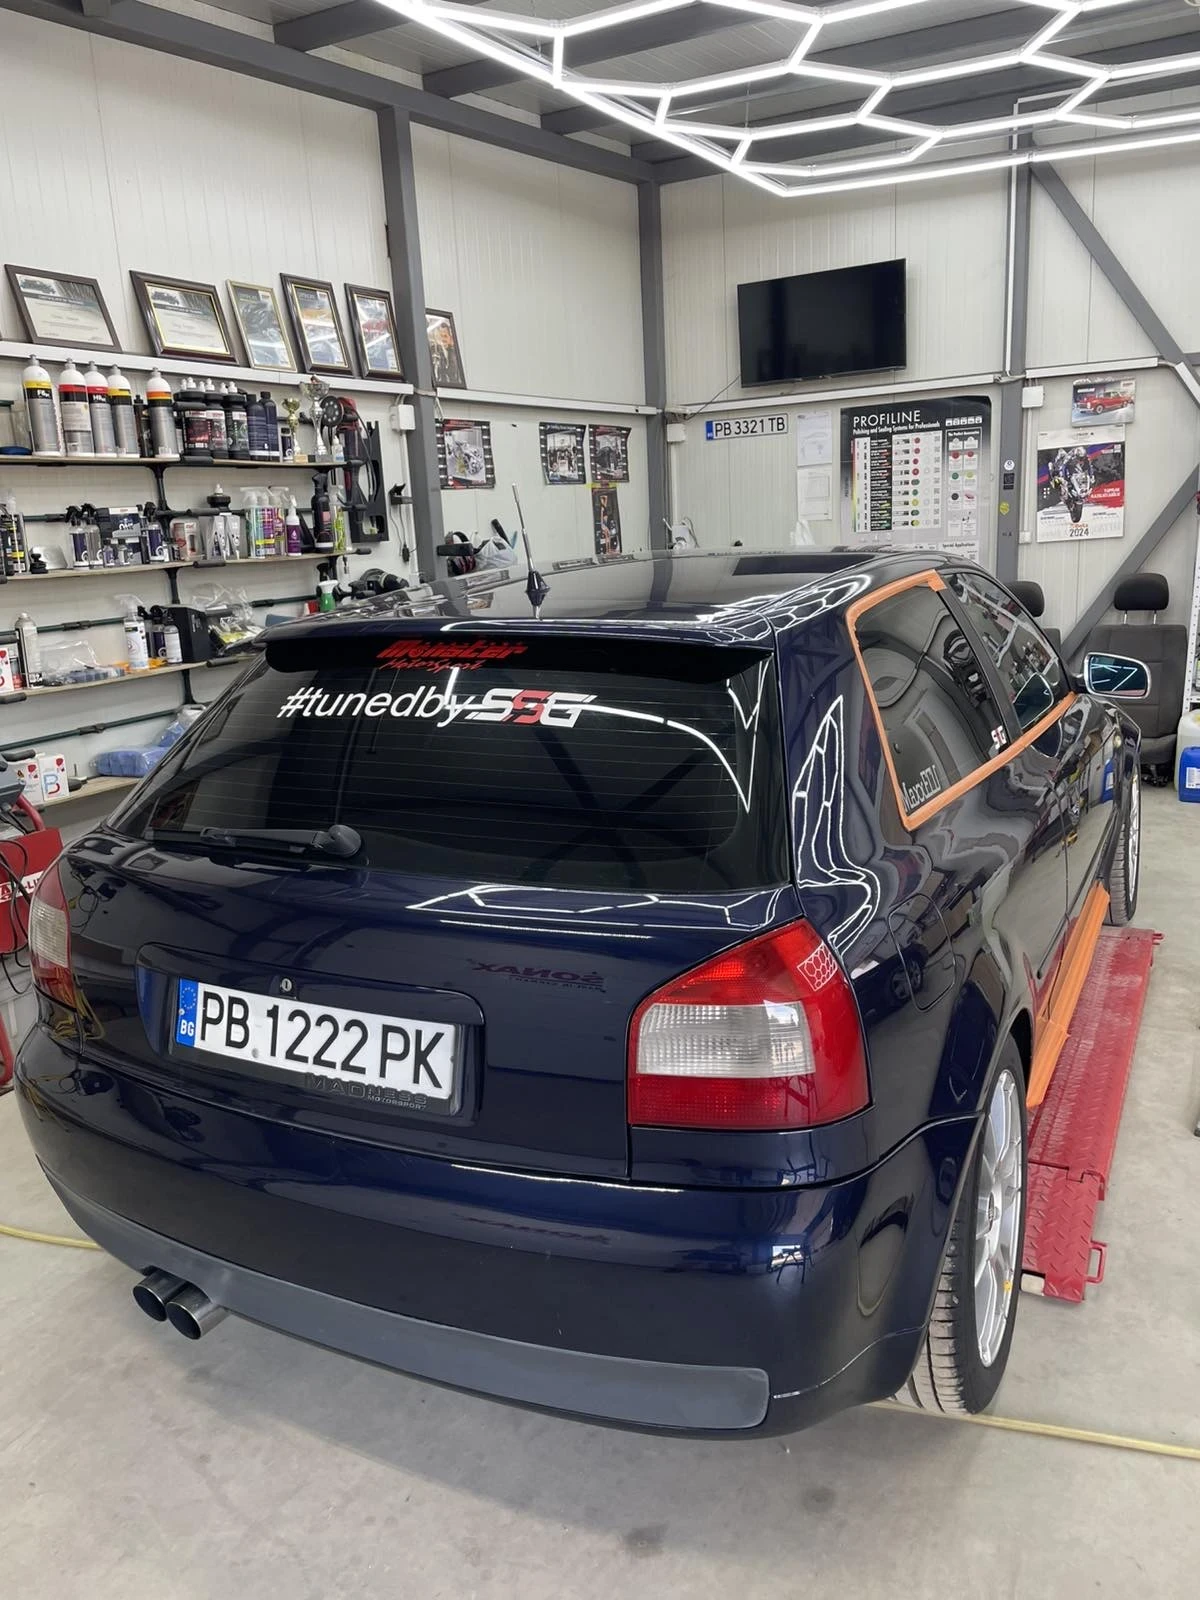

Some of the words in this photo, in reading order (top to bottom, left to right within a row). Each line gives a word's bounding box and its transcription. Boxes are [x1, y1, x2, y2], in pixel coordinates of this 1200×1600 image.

[714, 421, 732, 437] PB
[734, 419, 764, 435] 3321
[768, 416, 786, 432] TB
[853, 410, 921, 428] PROFILINE
[1069, 527, 1090, 538] 2024
[180, 1019, 195, 1037] BG
[199, 990, 251, 1050] PB
[266, 1004, 369, 1075] 1222
[379, 1023, 445, 1089] PK
